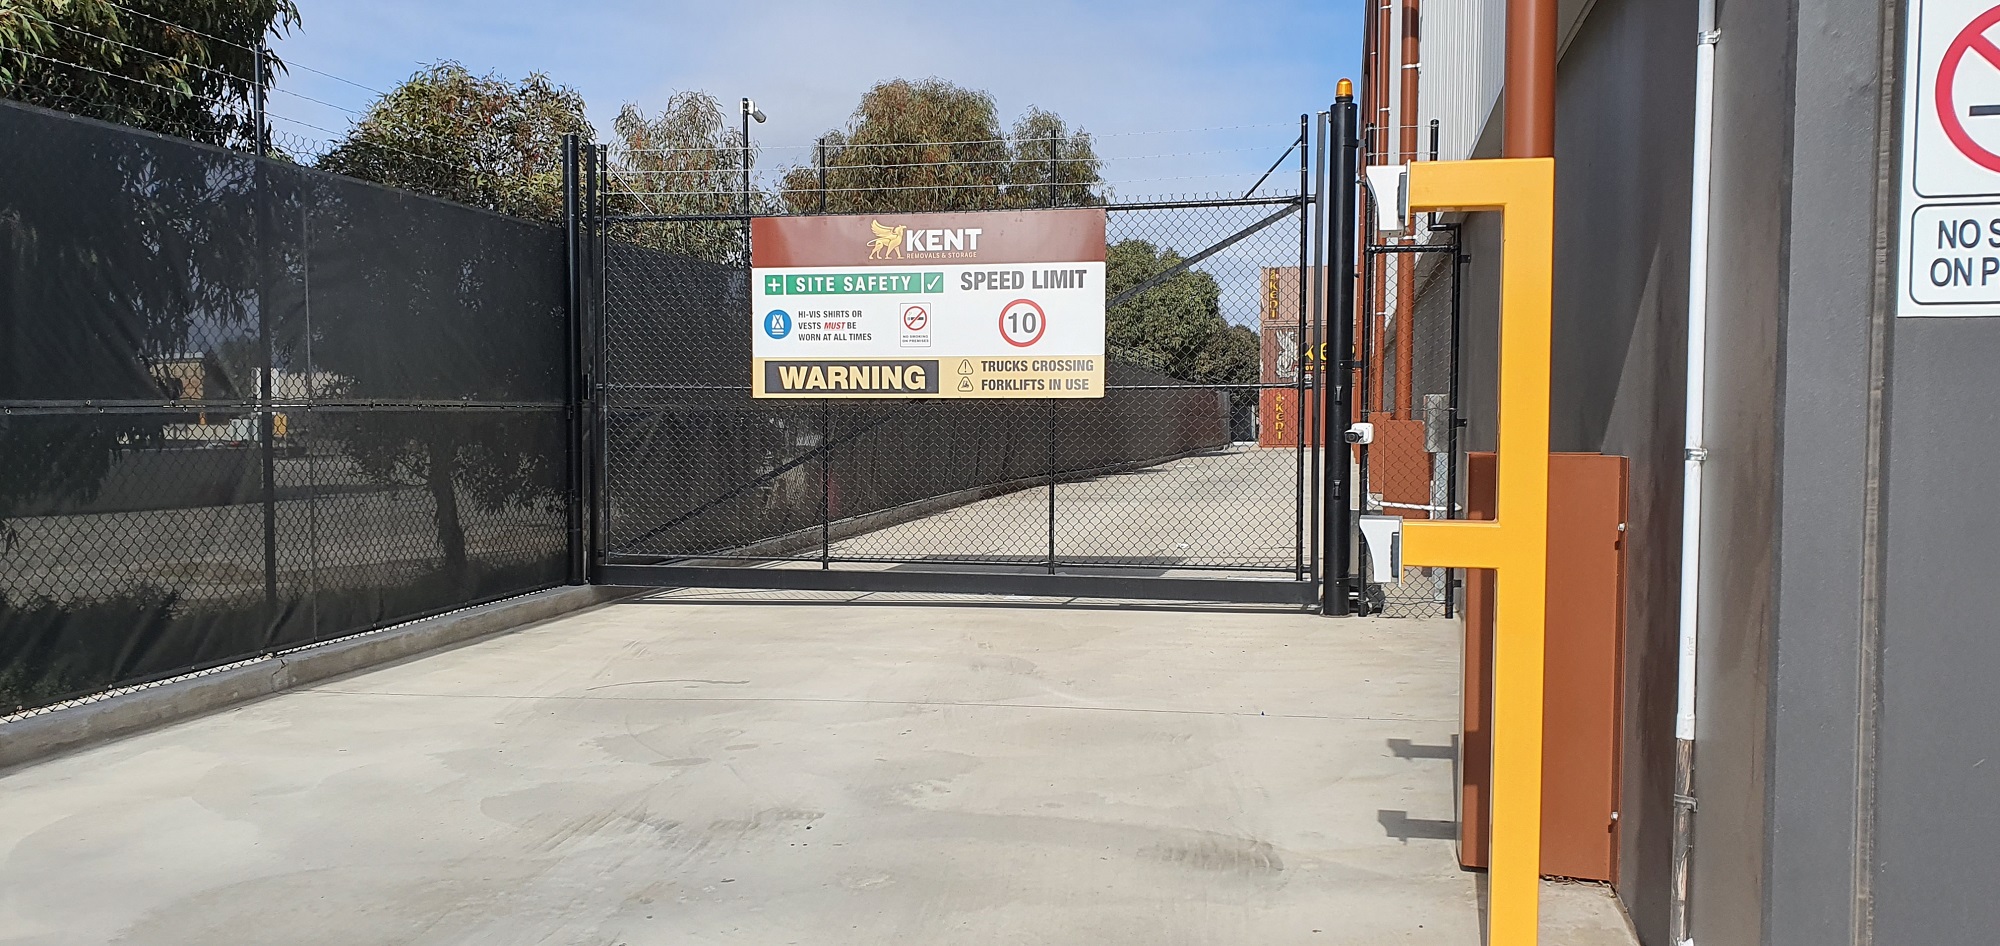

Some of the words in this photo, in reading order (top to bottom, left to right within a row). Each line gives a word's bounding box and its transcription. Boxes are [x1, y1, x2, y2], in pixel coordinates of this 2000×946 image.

[906, 228, 982, 251] KENT
[1938, 219, 1981, 249] NO
[960, 270, 1025, 291] SPEED
[1032, 269, 1087, 289] LIMIT
[1930, 257, 1973, 287] ON
[796, 276, 835, 292] SITE
[843, 275, 911, 291] SAFETY
[798, 310, 821, 318] HI-VIS
[823, 310, 850, 318] SHIRTS
[851, 310, 862, 318] OR
[1008, 312, 1037, 334] 10
[798, 322, 821, 330] VESTS
[824, 322, 846, 330] MUST
[847, 321, 857, 329] BE
[798, 333, 821, 341] WORN
[823, 333, 832, 341] AT
[833, 333, 847, 341] ALL
[848, 333, 872, 341] TIMES
[981, 360, 1028, 372] TRUCKS
[1032, 359, 1094, 371] CROSSING
[778, 365, 926, 390] WARNING
[981, 379, 1045, 391] FORKLIFTS
[1049, 379, 1061, 390] IN
[1065, 379, 1089, 390] USE
